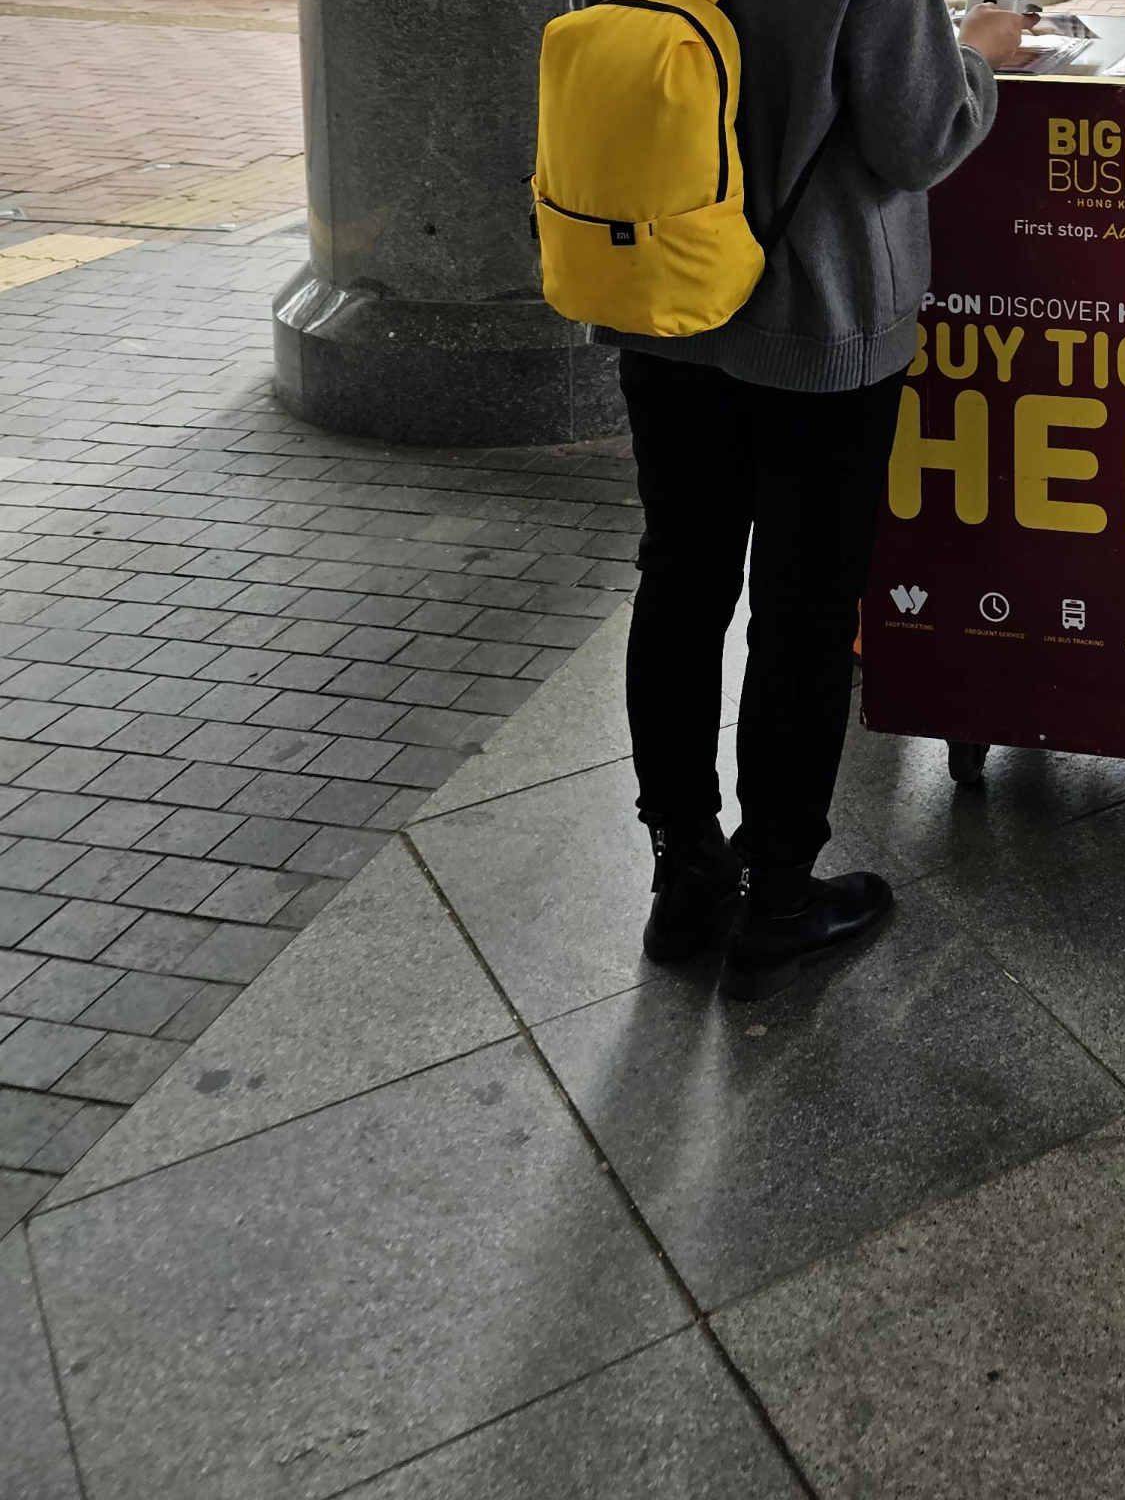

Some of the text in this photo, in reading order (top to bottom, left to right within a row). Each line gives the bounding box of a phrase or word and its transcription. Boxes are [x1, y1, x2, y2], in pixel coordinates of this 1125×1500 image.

[1048, 117, 1122, 158] BIG
[1048, 158, 1122, 195] BUS
[1077, 197, 1113, 209] HONG
[1014, 219, 1053, 236] First
[1057, 222, 1098, 241] stop.
[921, 292, 981, 315] P-ON
[989, 295, 1110, 322] DISCOVER
[885, 620, 934, 631] EASY TICKETING
[965, 628, 1026, 640] FREQUENT SERVICE
[1058, 636, 1072, 644] BUS
[1072, 638, 1105, 647] TRACKING
